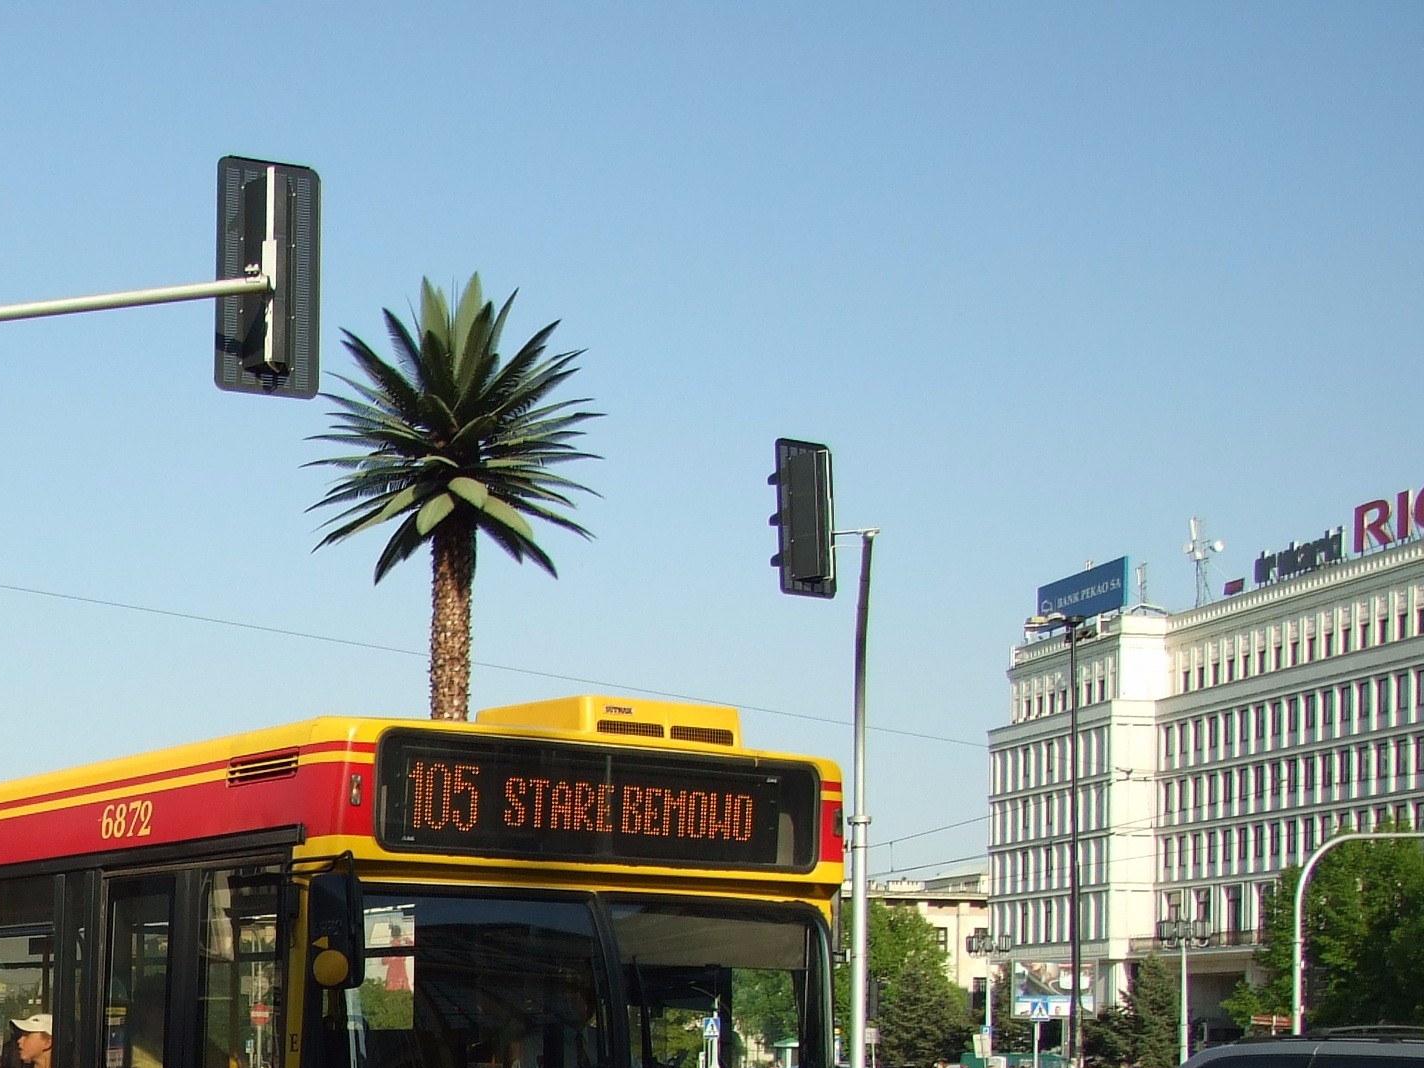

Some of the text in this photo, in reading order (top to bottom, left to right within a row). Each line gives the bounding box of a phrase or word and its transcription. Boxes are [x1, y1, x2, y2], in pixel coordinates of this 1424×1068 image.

[1057, 578, 1121, 609] BANK PEKAO SA
[101, 800, 153, 840] 6872
[408, 760, 754, 843] 105 STARE BEMOWO
